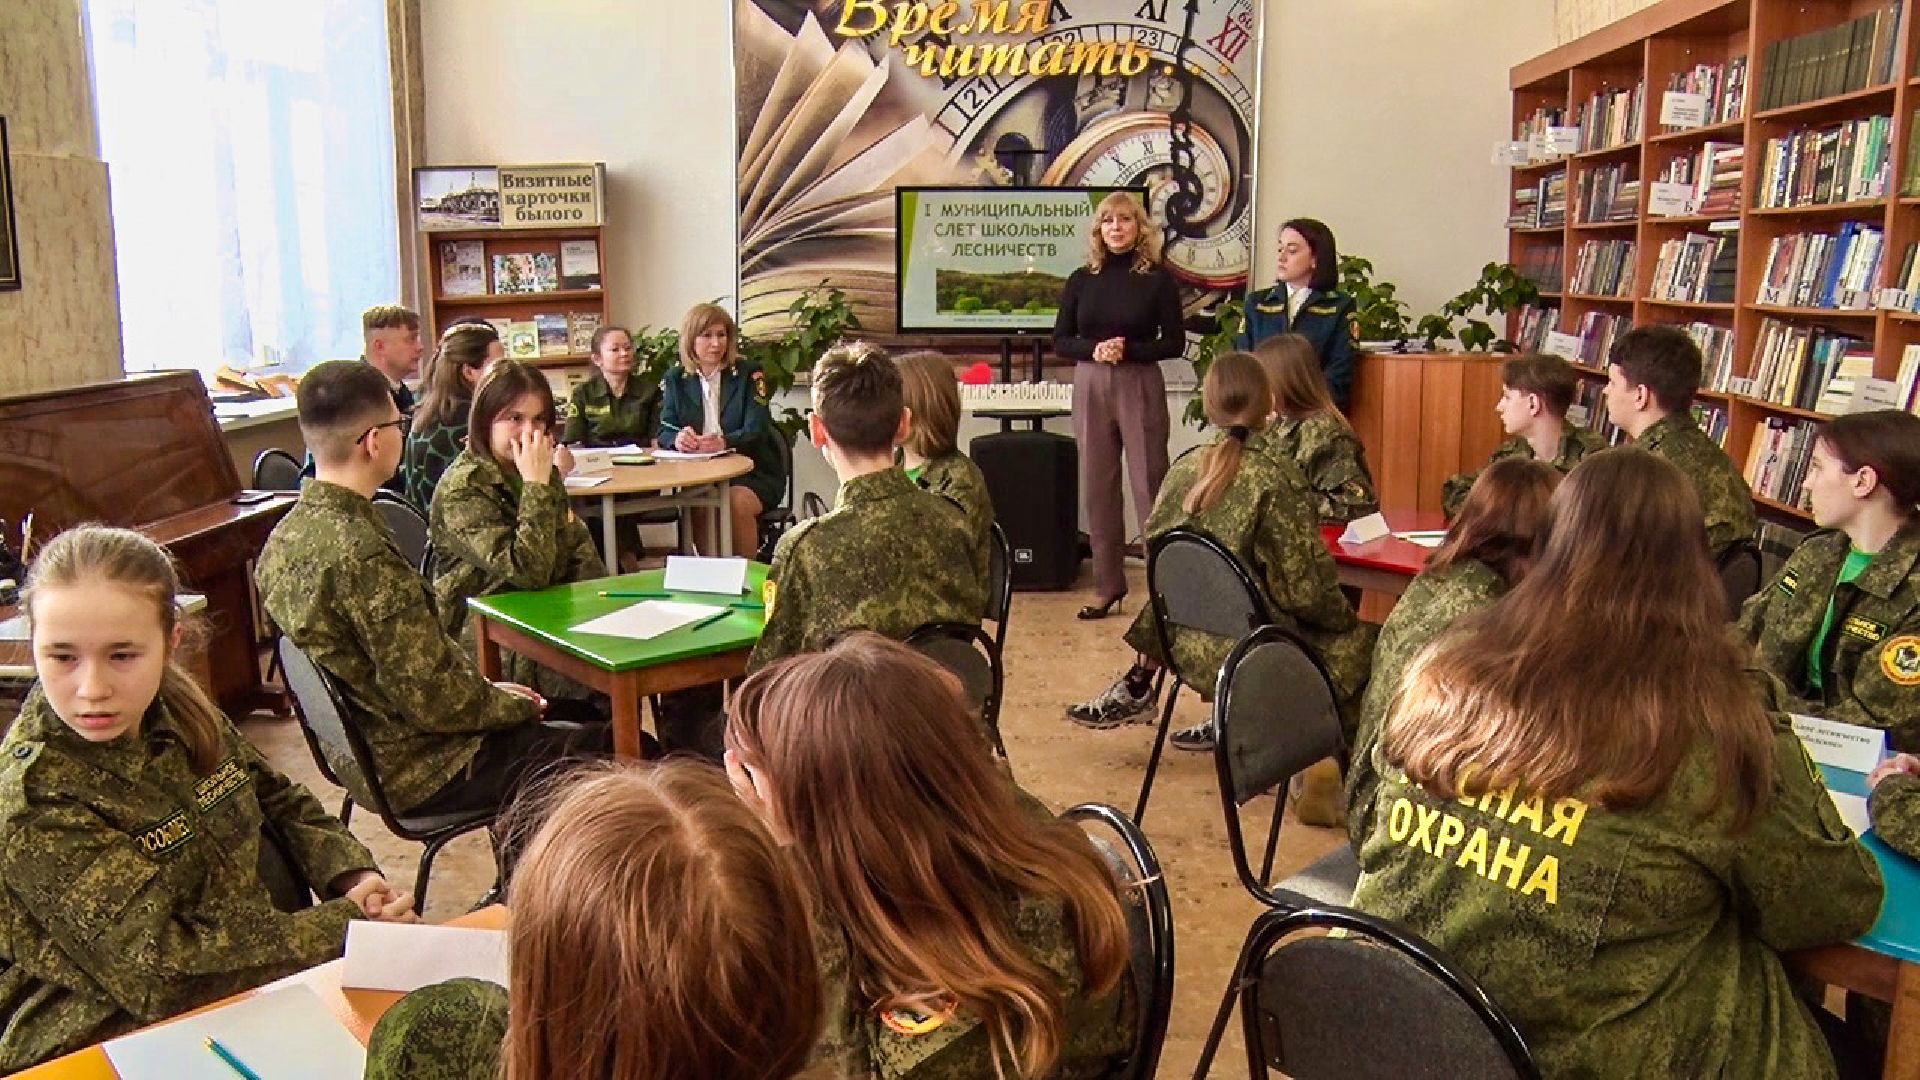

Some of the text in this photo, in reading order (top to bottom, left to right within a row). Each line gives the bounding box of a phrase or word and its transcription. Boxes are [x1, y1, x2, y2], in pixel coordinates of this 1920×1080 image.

[834, 0, 1050, 47] Время
[1137, 29, 1158, 46] 23
[1206, 15, 1250, 63] XII
[963, 78, 992, 109] 21
[502, 174, 593, 189] Визитные
[504, 191, 590, 208] карточки
[515, 206, 583, 221] былого
[941, 201, 1090, 220] МУНИЦИПАЛЬНЫЙ
[934, 223, 1075, 237] СЛЕТ ШКОЛЬНЫХ
[952, 243, 1057, 257] ЛЕСНИЧЕСТВ
[1398, 763, 1588, 846] СНАЯ
[1389, 798, 1559, 905] ОХРАНА
